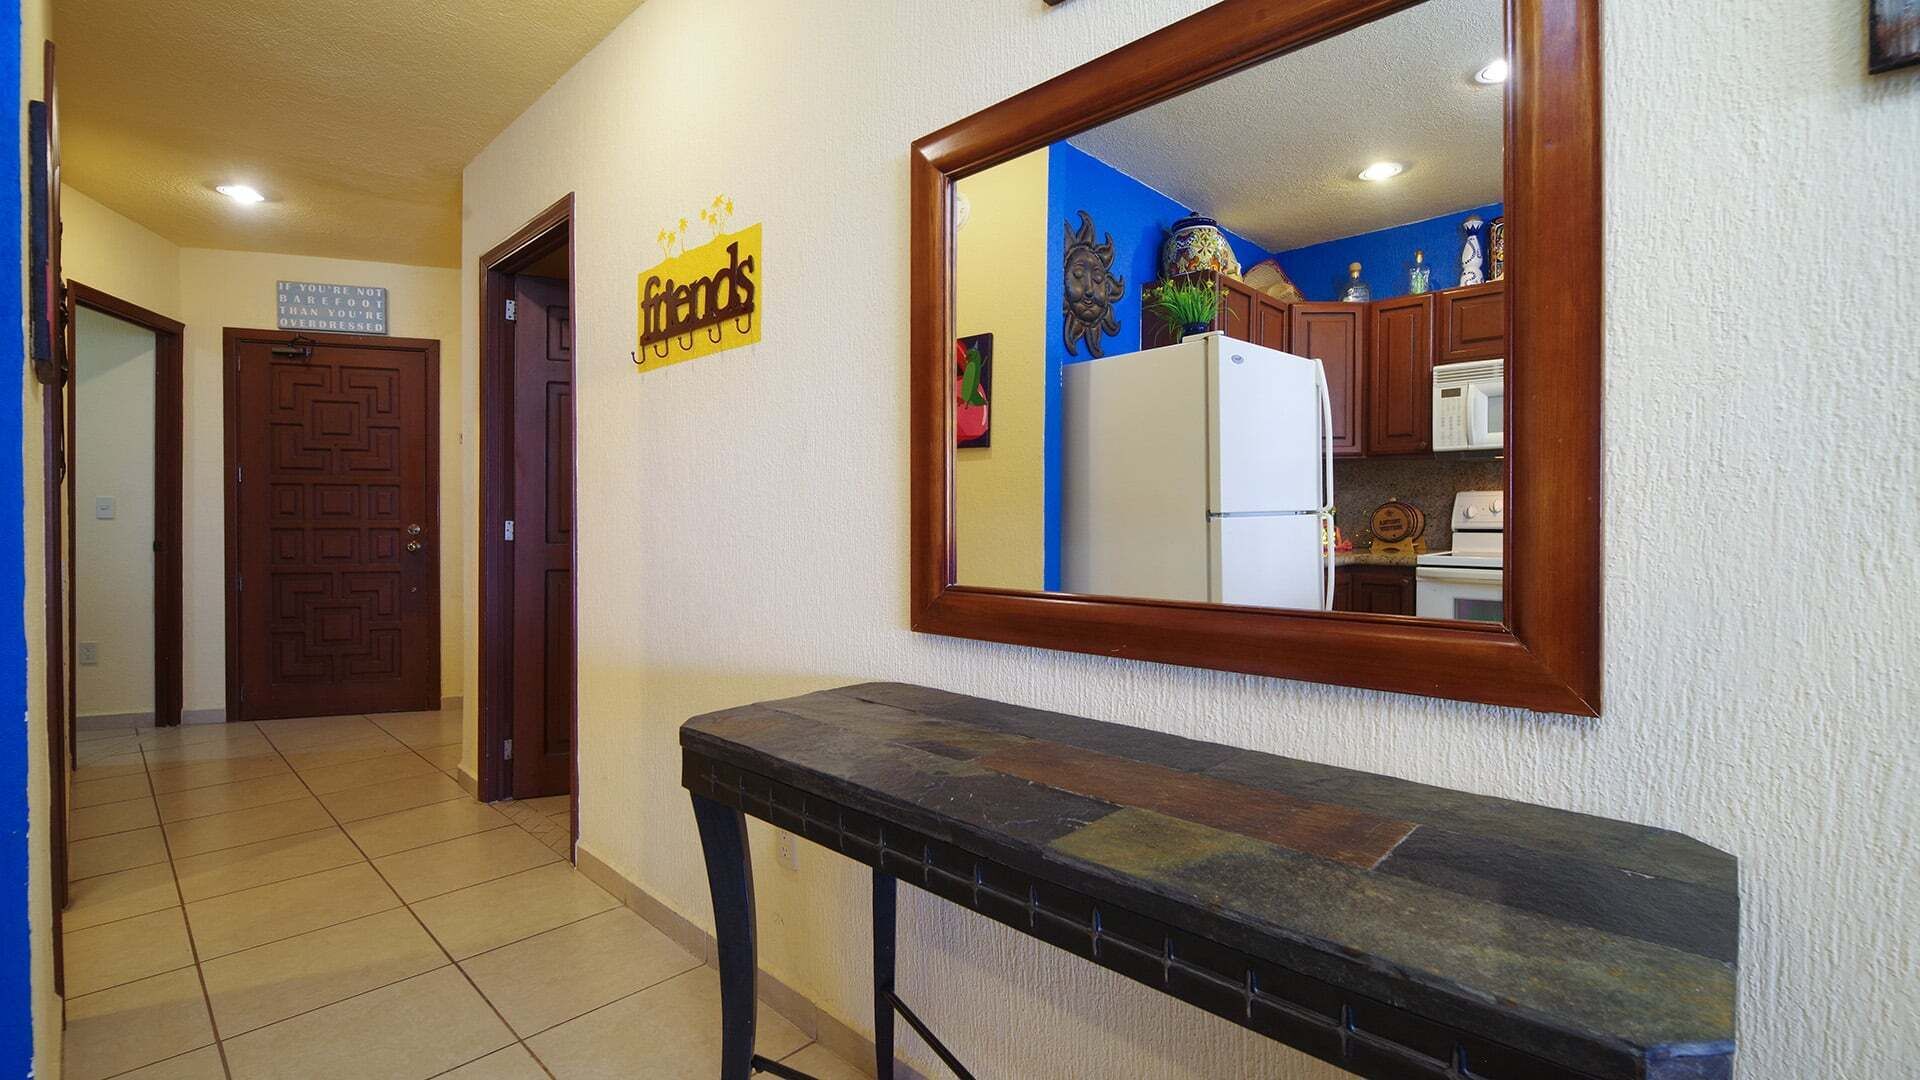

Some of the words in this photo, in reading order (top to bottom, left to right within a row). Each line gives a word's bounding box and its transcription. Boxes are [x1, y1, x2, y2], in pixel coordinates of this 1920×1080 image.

[279, 282, 290, 291] IF
[300, 283, 350, 295] YOU'RE
[357, 288, 382, 297] NOT
[641, 241, 754, 341] friends
[279, 294, 382, 309] BAREFOOT
[279, 306, 318, 316] THAN
[328, 309, 383, 321] YOU'RE
[280, 318, 383, 331] OVERDRESSED
